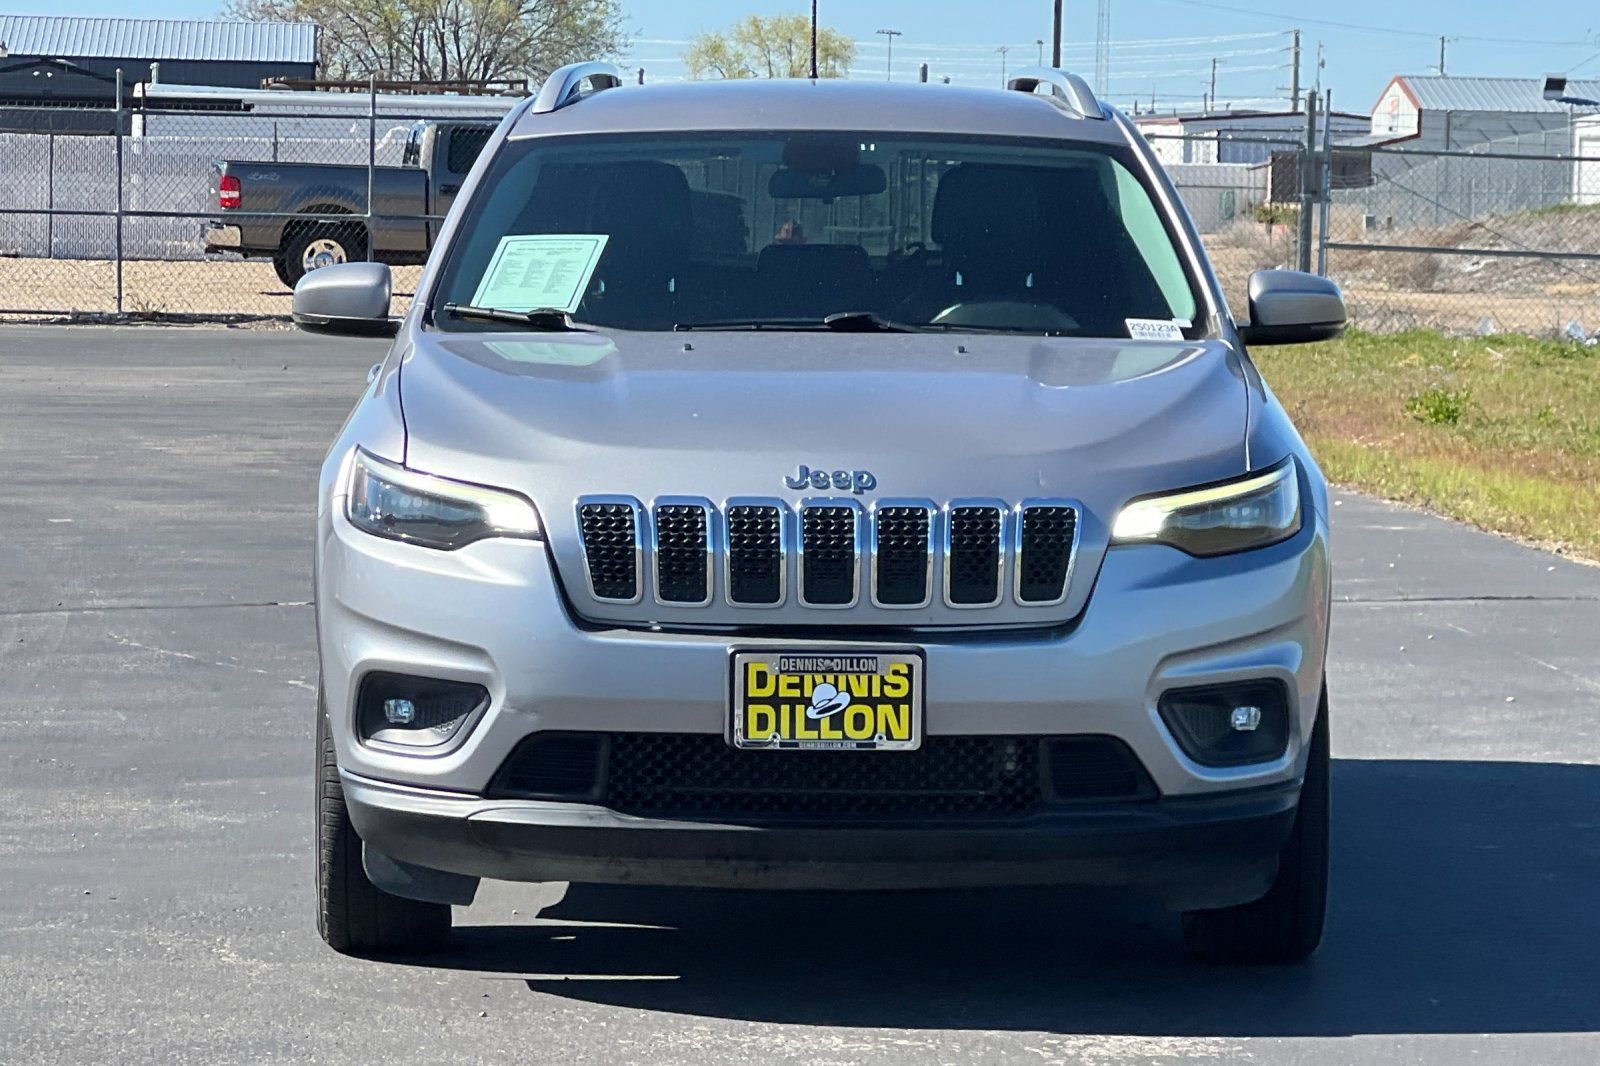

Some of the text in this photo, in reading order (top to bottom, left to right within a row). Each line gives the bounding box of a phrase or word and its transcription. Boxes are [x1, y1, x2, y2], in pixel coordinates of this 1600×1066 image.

[783, 465, 877, 495] Jeep
[781, 658, 877, 672] DENNIS DILLON
[748, 704, 910, 739] DILLON
